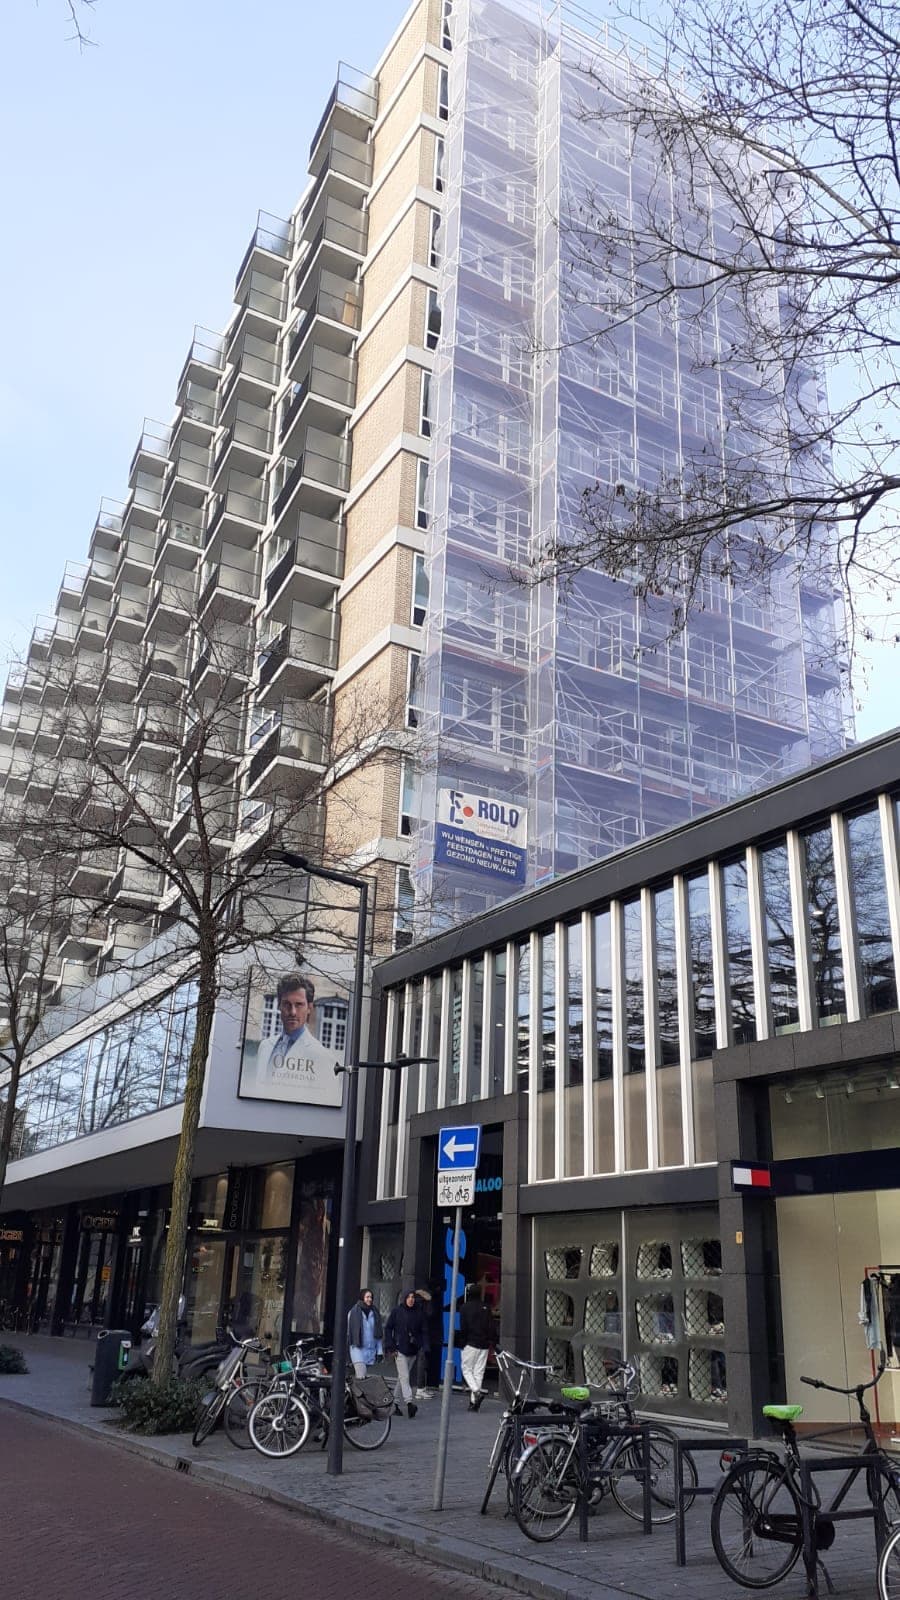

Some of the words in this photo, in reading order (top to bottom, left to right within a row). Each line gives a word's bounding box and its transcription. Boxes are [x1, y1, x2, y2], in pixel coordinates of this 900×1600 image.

[478, 799, 519, 829] ROLO
[441, 831, 454, 840] WIJ
[455, 834, 485, 849] WENSEN
[446, 850, 475, 864] GEZOND
[476, 859, 516, 876] NIEUWJAAR
[447, 841, 491, 859] FEESTDAGEN
[502, 858, 517, 868] EEN
[273, 1054, 315, 1074] OGER
[439, 1174, 473, 1186] uitgezonderd
[475, 1177, 502, 1193] ALOO
